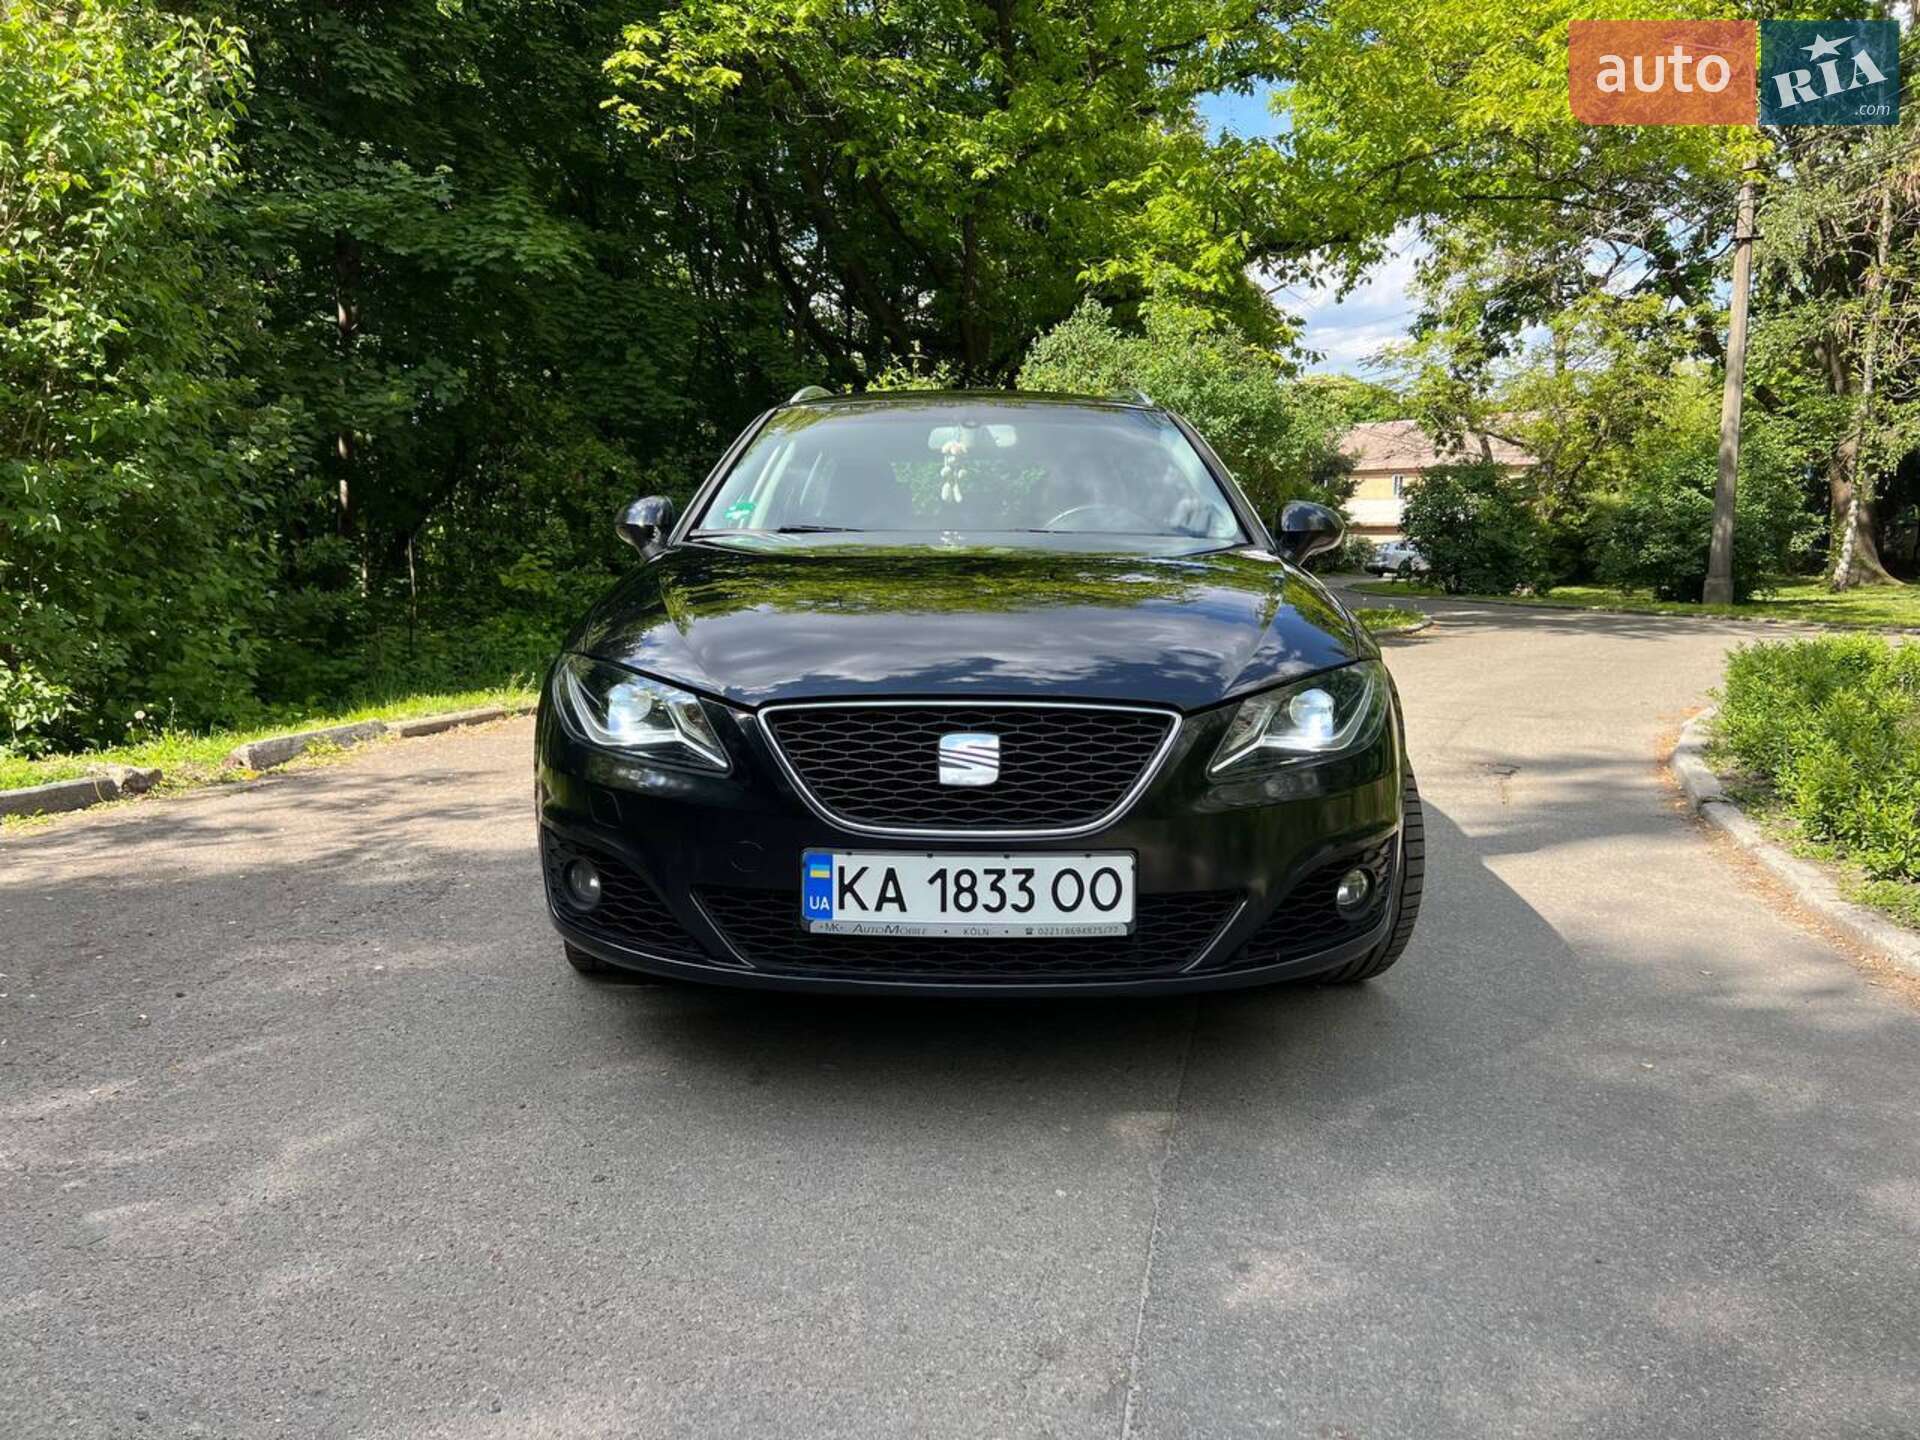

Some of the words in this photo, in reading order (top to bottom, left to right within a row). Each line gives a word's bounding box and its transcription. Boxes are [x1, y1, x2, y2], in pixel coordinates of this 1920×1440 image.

[809, 895, 830, 911] UA
[838, 865, 908, 912] KA
[927, 868, 1035, 913] 1833
[1051, 866, 1123, 912] OO
